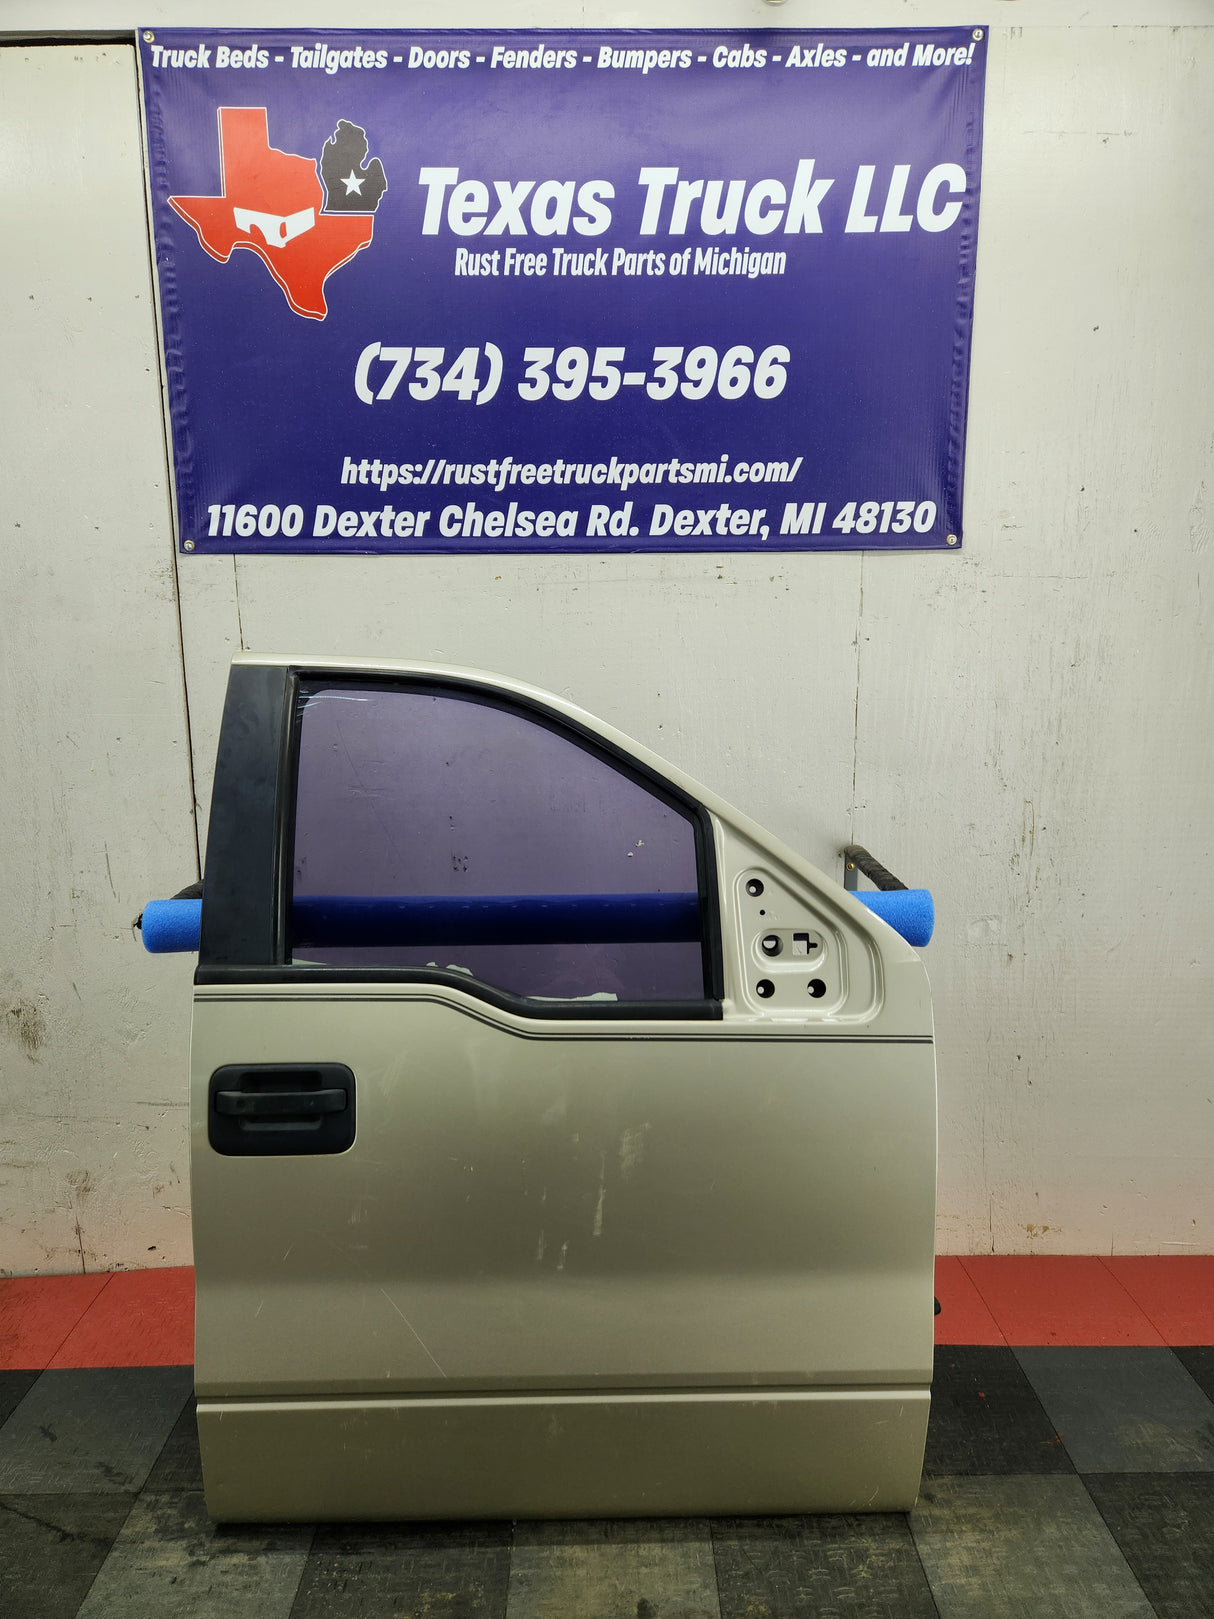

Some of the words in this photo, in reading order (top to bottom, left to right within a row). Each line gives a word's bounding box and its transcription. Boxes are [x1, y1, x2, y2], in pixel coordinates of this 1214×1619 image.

[151, 43, 211, 69] Truck
[216, 43, 270, 69] Beds
[290, 42, 388, 75] Tailgates
[408, 44, 472, 69] Doors
[490, 43, 578, 69] Fenders
[597, 44, 693, 75] Bumpers
[697, 54, 707, 62] -
[712, 43, 767, 69] Cabs
[772, 54, 782, 62] -
[785, 42, 848, 68] Axles
[852, 54, 862, 62] -
[866, 42, 911, 68] and
[912, 42, 977, 67] More!
[418, 167, 616, 237] Texas
[637, 158, 835, 236] Truck
[843, 162, 968, 234] LLC
[454, 247, 501, 277] Rust
[503, 248, 548, 277] Free
[551, 247, 610, 277] Truck
[611, 247, 667, 277] Parts
[668, 246, 692, 276] of
[692, 246, 787, 280] Michigan
[354, 341, 504, 406] (734)
[517, 344, 791, 402] 395-3966
[340, 453, 804, 491] https://rustfreetruckpartsmi.com/
[207, 503, 304, 538] 11600
[312, 503, 432, 538] Dexter
[438, 501, 580, 538] Chelsea
[585, 501, 640, 537] Rd.
[648, 503, 770, 541] Dexter,
[779, 502, 828, 536] MI
[831, 501, 937, 535] 48130
